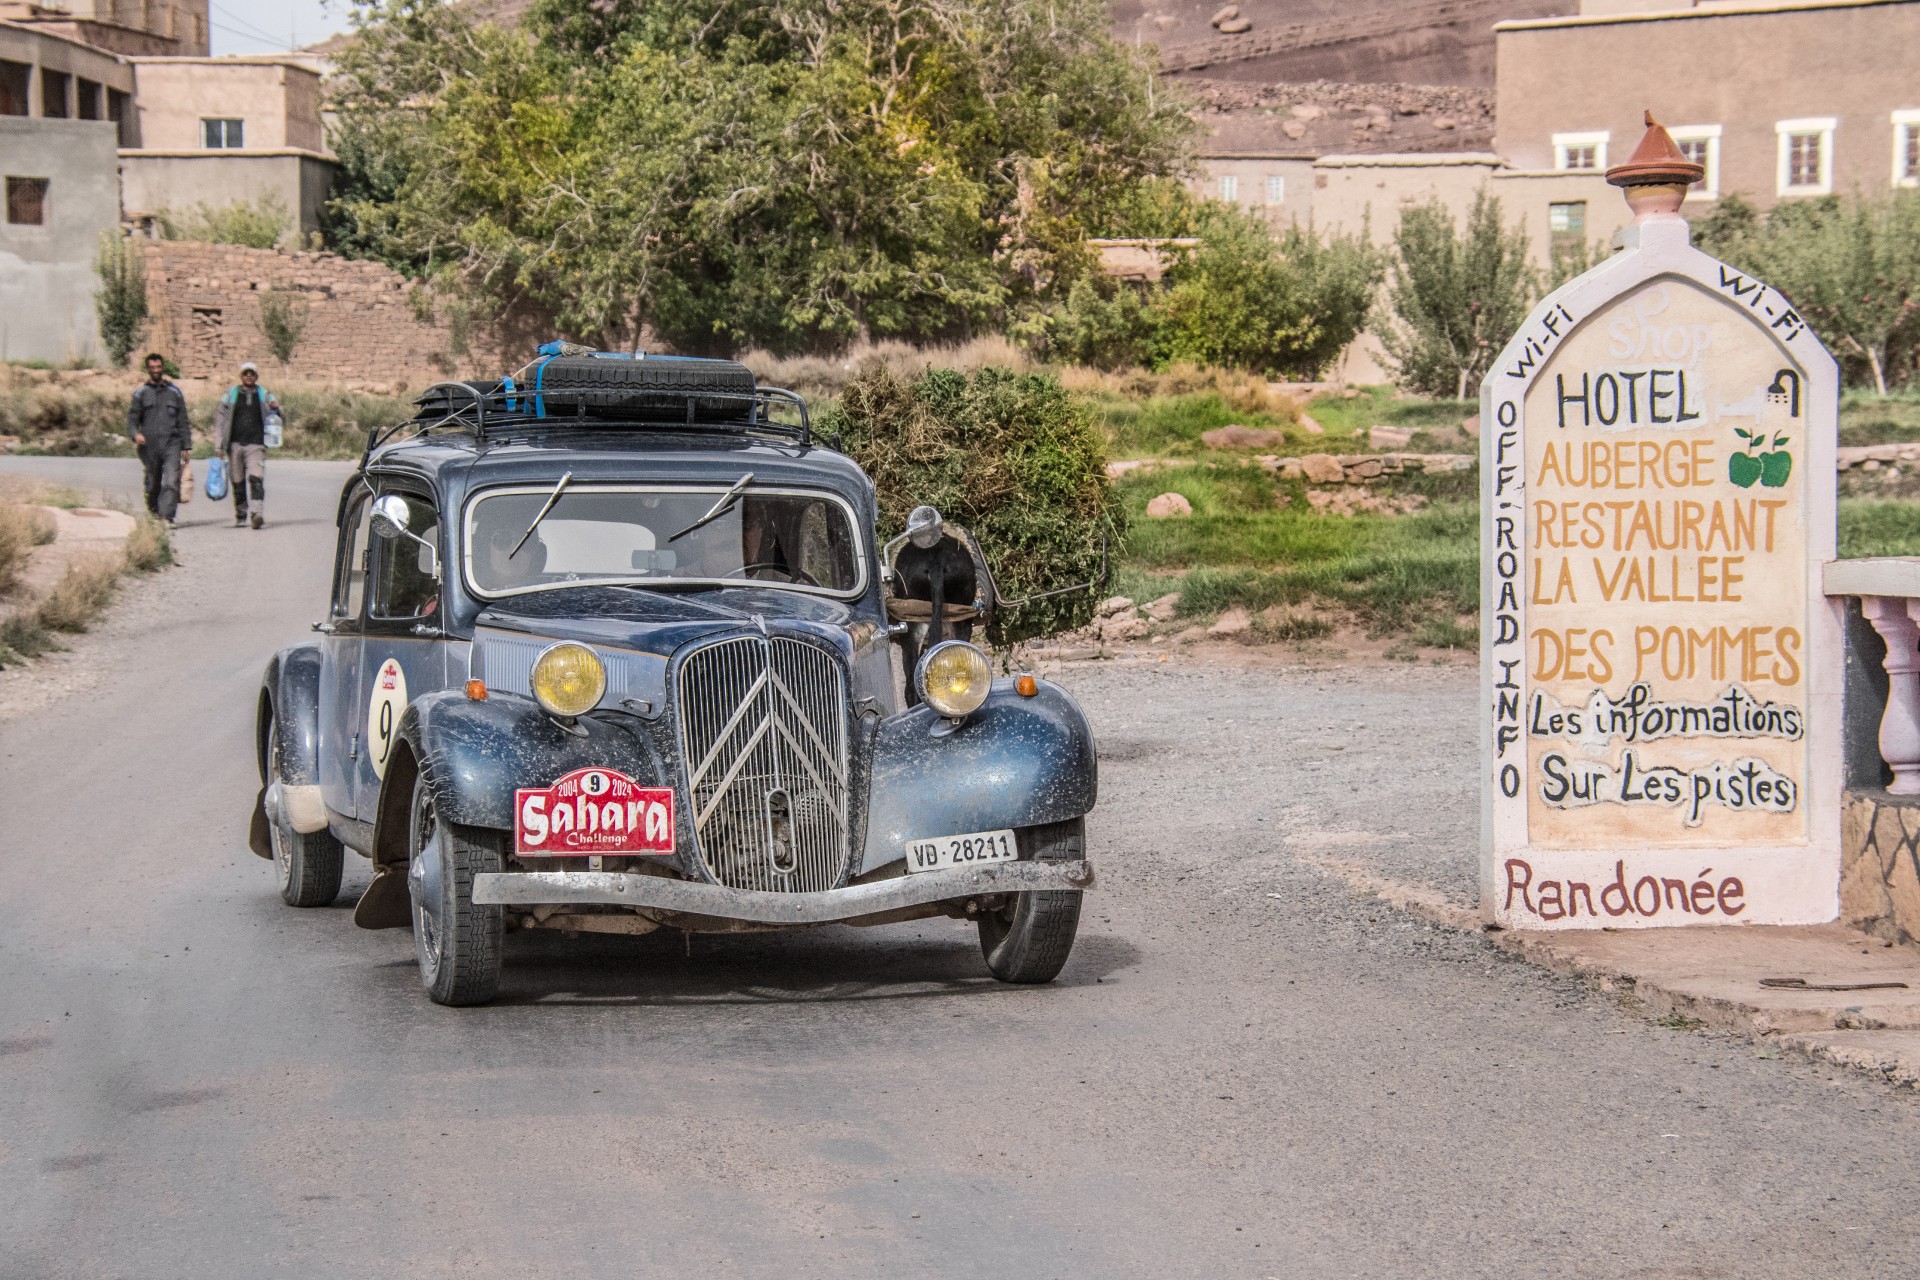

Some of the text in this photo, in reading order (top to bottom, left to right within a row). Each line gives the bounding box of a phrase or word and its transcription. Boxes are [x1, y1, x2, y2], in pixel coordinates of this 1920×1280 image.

[1556, 369, 1699, 428] HOTEL
[1536, 439, 1716, 489] AUBERGE
[1533, 499, 1787, 553] RESTAURANT
[1532, 555, 1745, 605] LA VALLEE
[1530, 625, 1801, 686] DES POMMES
[380, 699, 392, 764] 9
[1496, 658, 1521, 799] INFO
[1531, 684, 1800, 742] Les informations
[558, 774, 632, 797] 2004 9 2024
[1543, 752, 1792, 821] Sur Les pistes
[522, 794, 668, 846] Sahara
[566, 831, 628, 846] Challenge
[1503, 858, 1746, 921] Randonée
